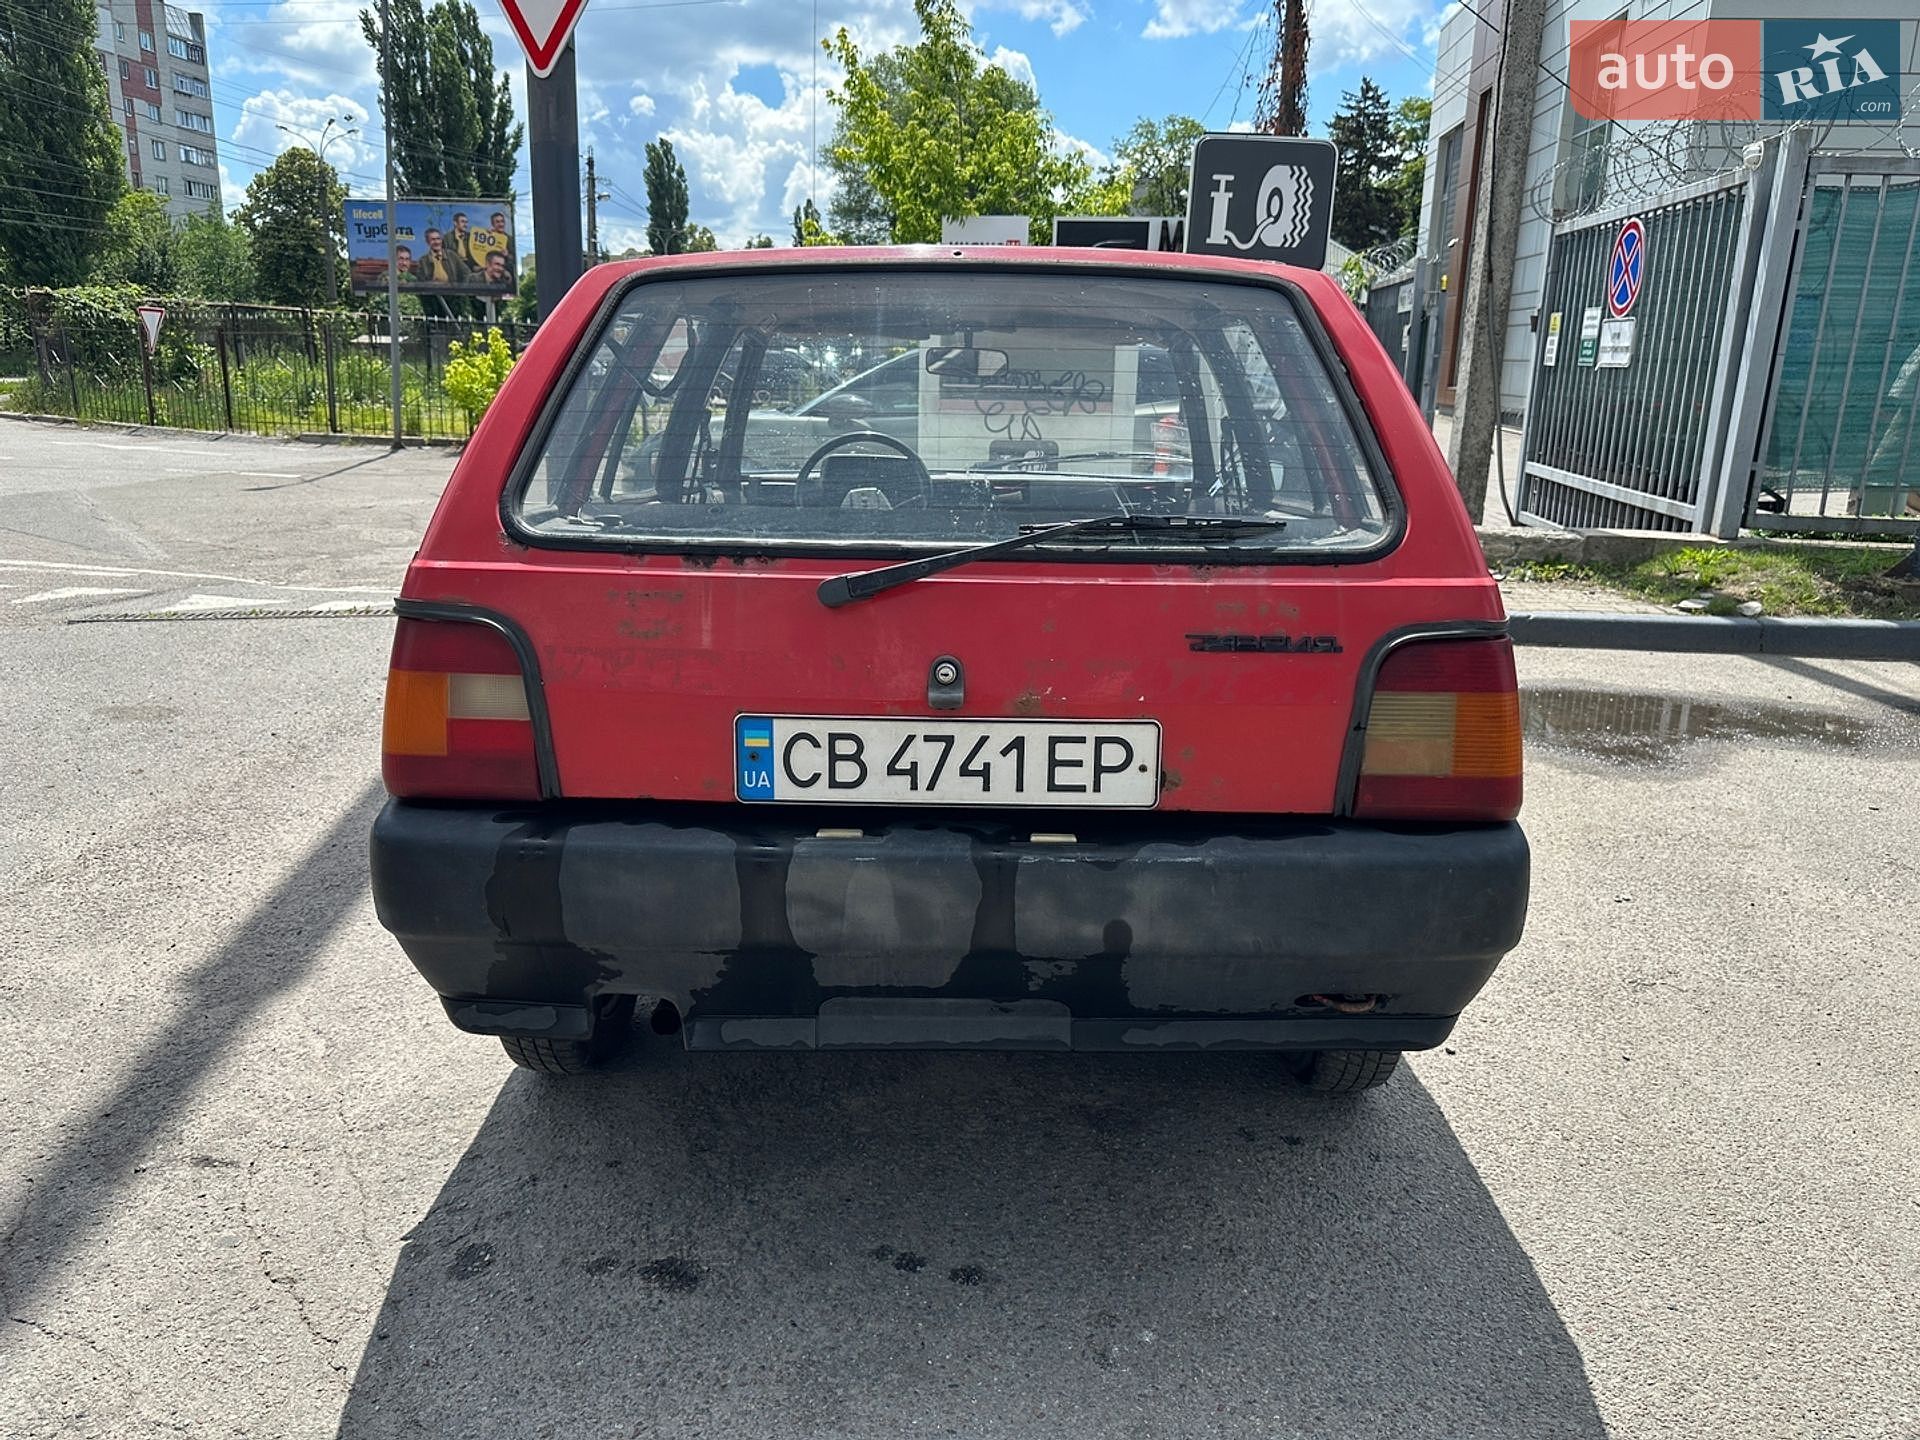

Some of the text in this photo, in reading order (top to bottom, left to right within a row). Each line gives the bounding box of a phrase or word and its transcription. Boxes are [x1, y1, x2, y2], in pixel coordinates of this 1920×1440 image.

[352, 208, 384, 219] lifecell
[354, 223, 414, 238] Турбта
[473, 231, 496, 247] 190
[782, 731, 1135, 793] CB 4741 EP
[743, 770, 771, 788] UA
